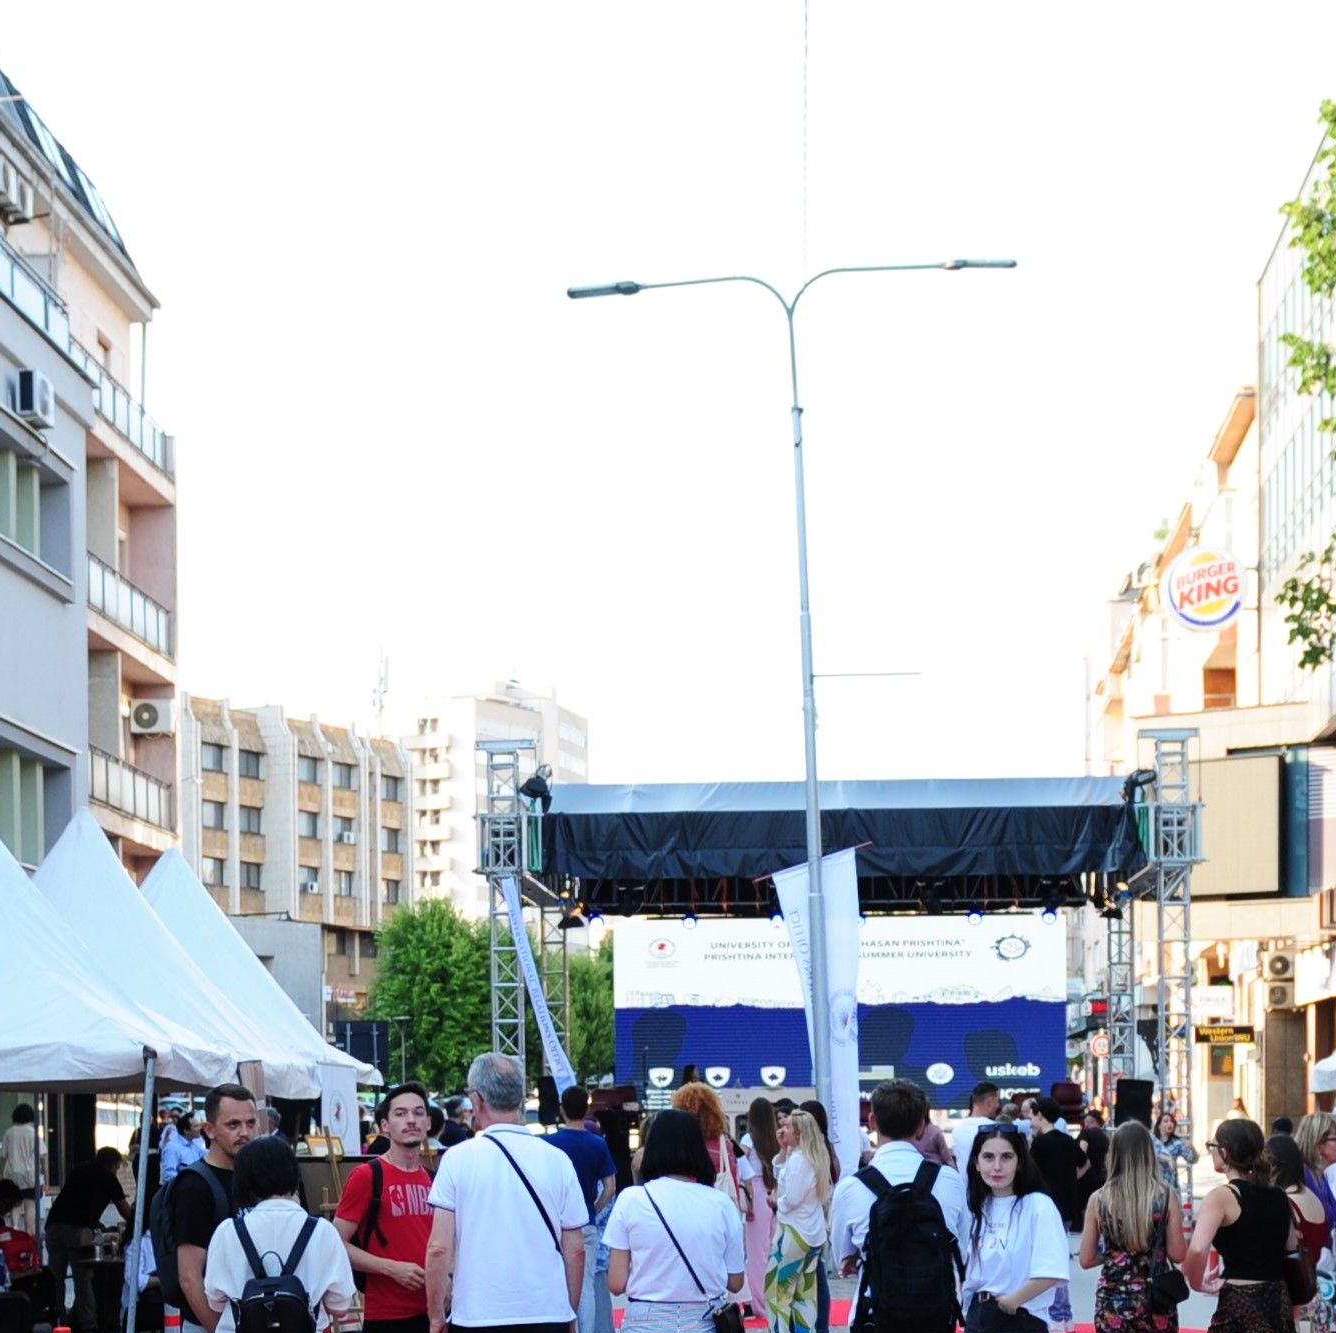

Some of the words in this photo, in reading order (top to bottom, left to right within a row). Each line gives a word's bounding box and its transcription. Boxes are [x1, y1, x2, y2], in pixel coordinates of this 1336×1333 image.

[1176, 561, 1236, 590] BURGER
[1179, 575, 1239, 610] KING
[709, 941, 775, 950] UNIVERSITY
[704, 952, 763, 961] PRISHTINA
[859, 951, 905, 959] UMMER
[906, 950, 972, 959] UNIVERSITY
[985, 1062, 1042, 1077] uskeb
